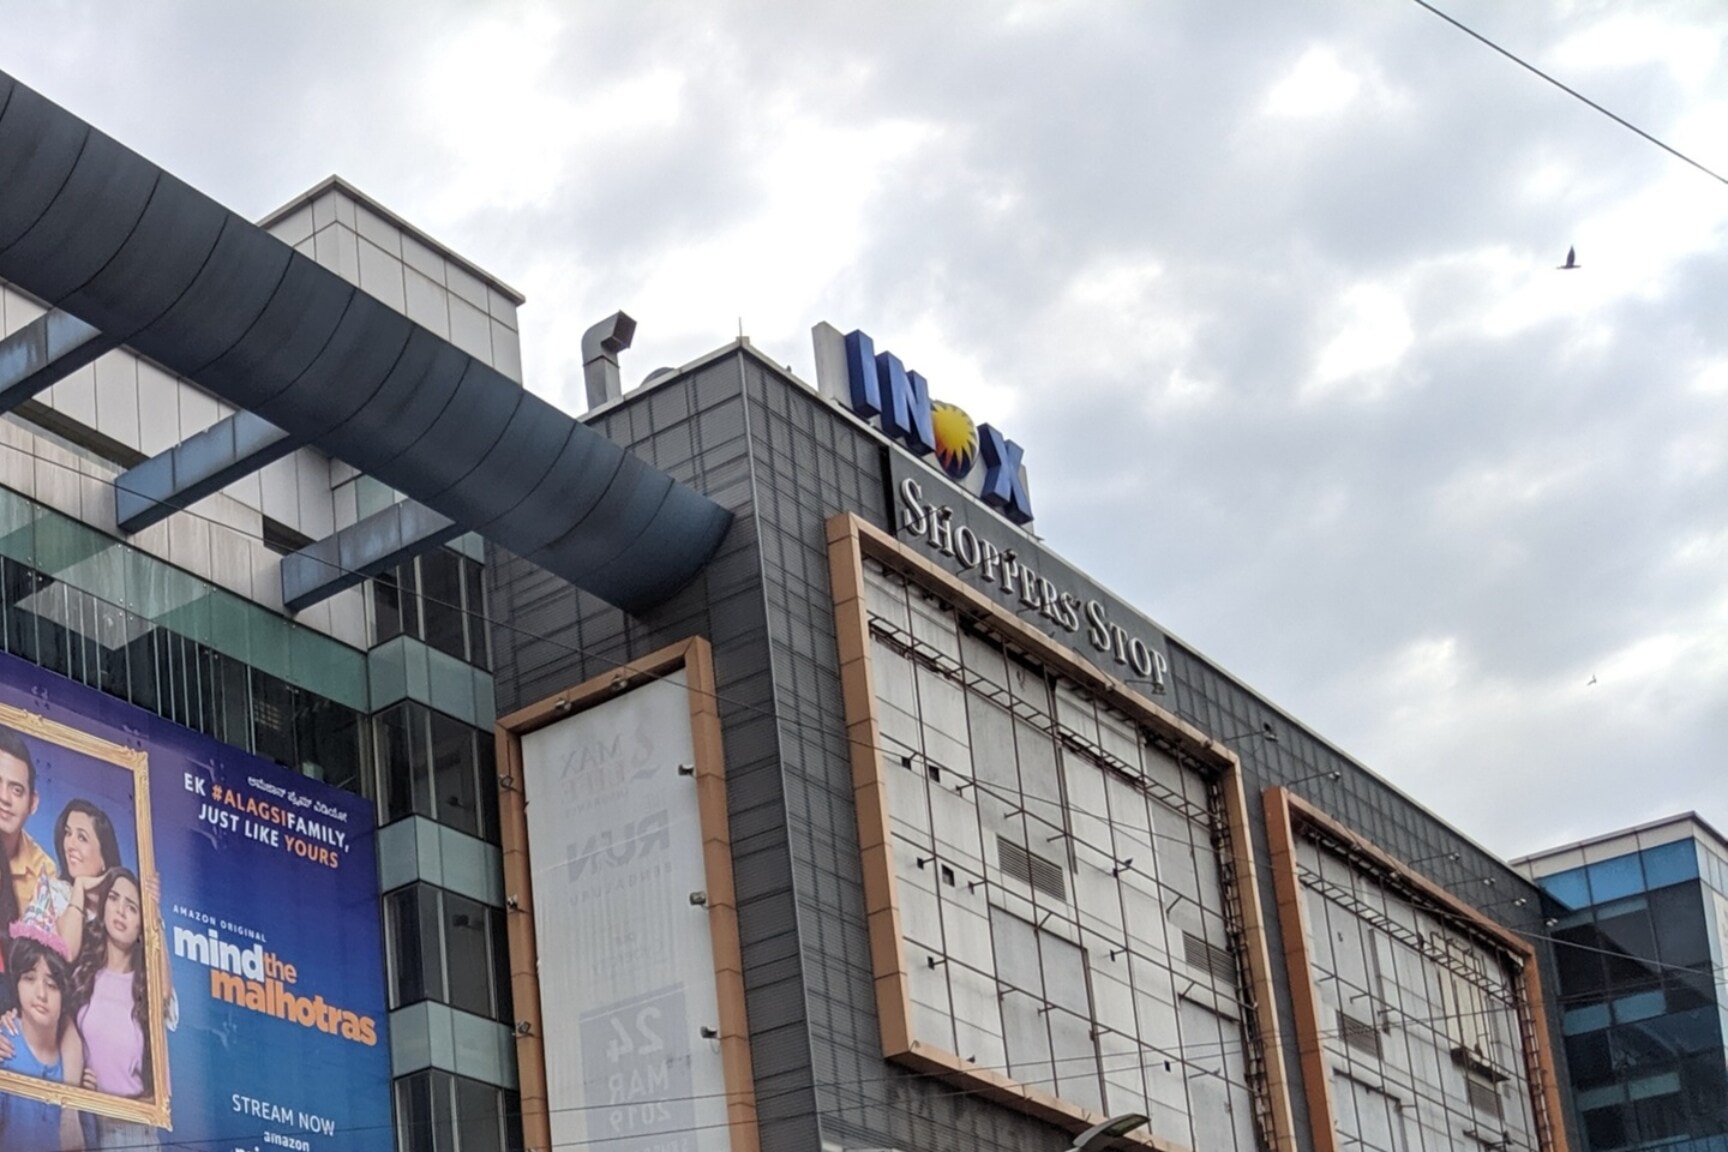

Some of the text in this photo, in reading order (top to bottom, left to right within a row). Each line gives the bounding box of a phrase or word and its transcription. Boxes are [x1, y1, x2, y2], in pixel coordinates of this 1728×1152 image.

[1085, 600, 1168, 689] STOP
[184, 772, 206, 797] EK
[199, 803, 339, 869] JUST LIKE YOURS
[173, 905, 267, 943] AMAZON ORIGINAL
[173, 925, 297, 984] mind the
[210, 968, 377, 1047] malhotras
[232, 1094, 335, 1137] STREAM NOW
[263, 1131, 310, 1152] amazon
